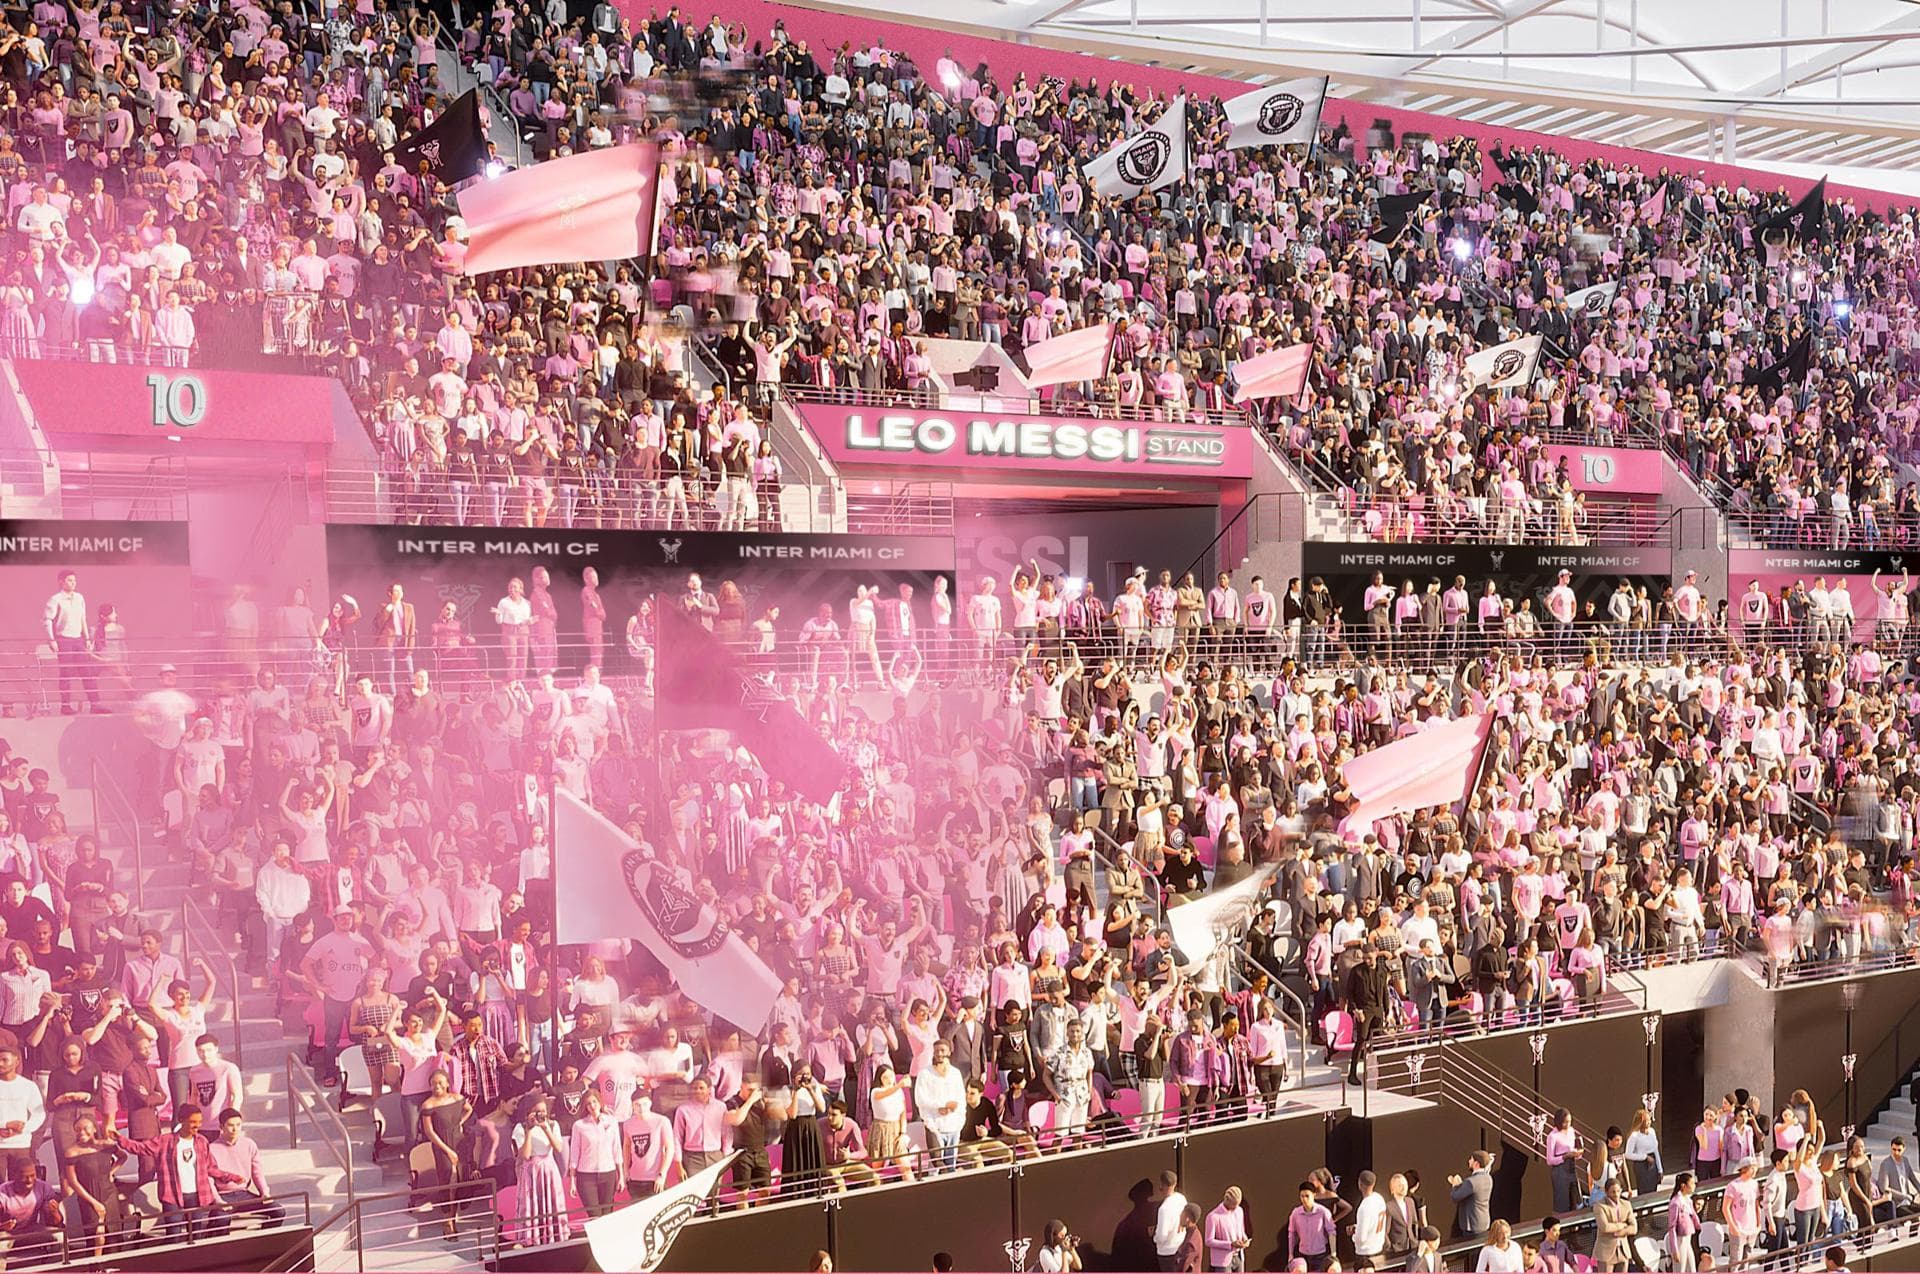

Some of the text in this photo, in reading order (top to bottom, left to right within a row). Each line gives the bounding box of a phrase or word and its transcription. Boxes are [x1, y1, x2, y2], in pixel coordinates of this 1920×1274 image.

[146, 374, 206, 427] 10
[847, 415, 1226, 461] LEO MESSI STAND
[1580, 453, 1616, 485] 10
[59, 537, 114, 552] MIAMI
[119, 537, 144, 552] CF
[398, 540, 600, 556] INTER MIAMI CF
[739, 545, 905, 560] INTER MIAMI CF
[1340, 554, 1456, 566] INTER MIAMI CF
[1537, 556, 1640, 567] INTER MIAMI CF
[1804, 558, 1841, 568] MIAMI
[1844, 559, 1861, 569] CF
